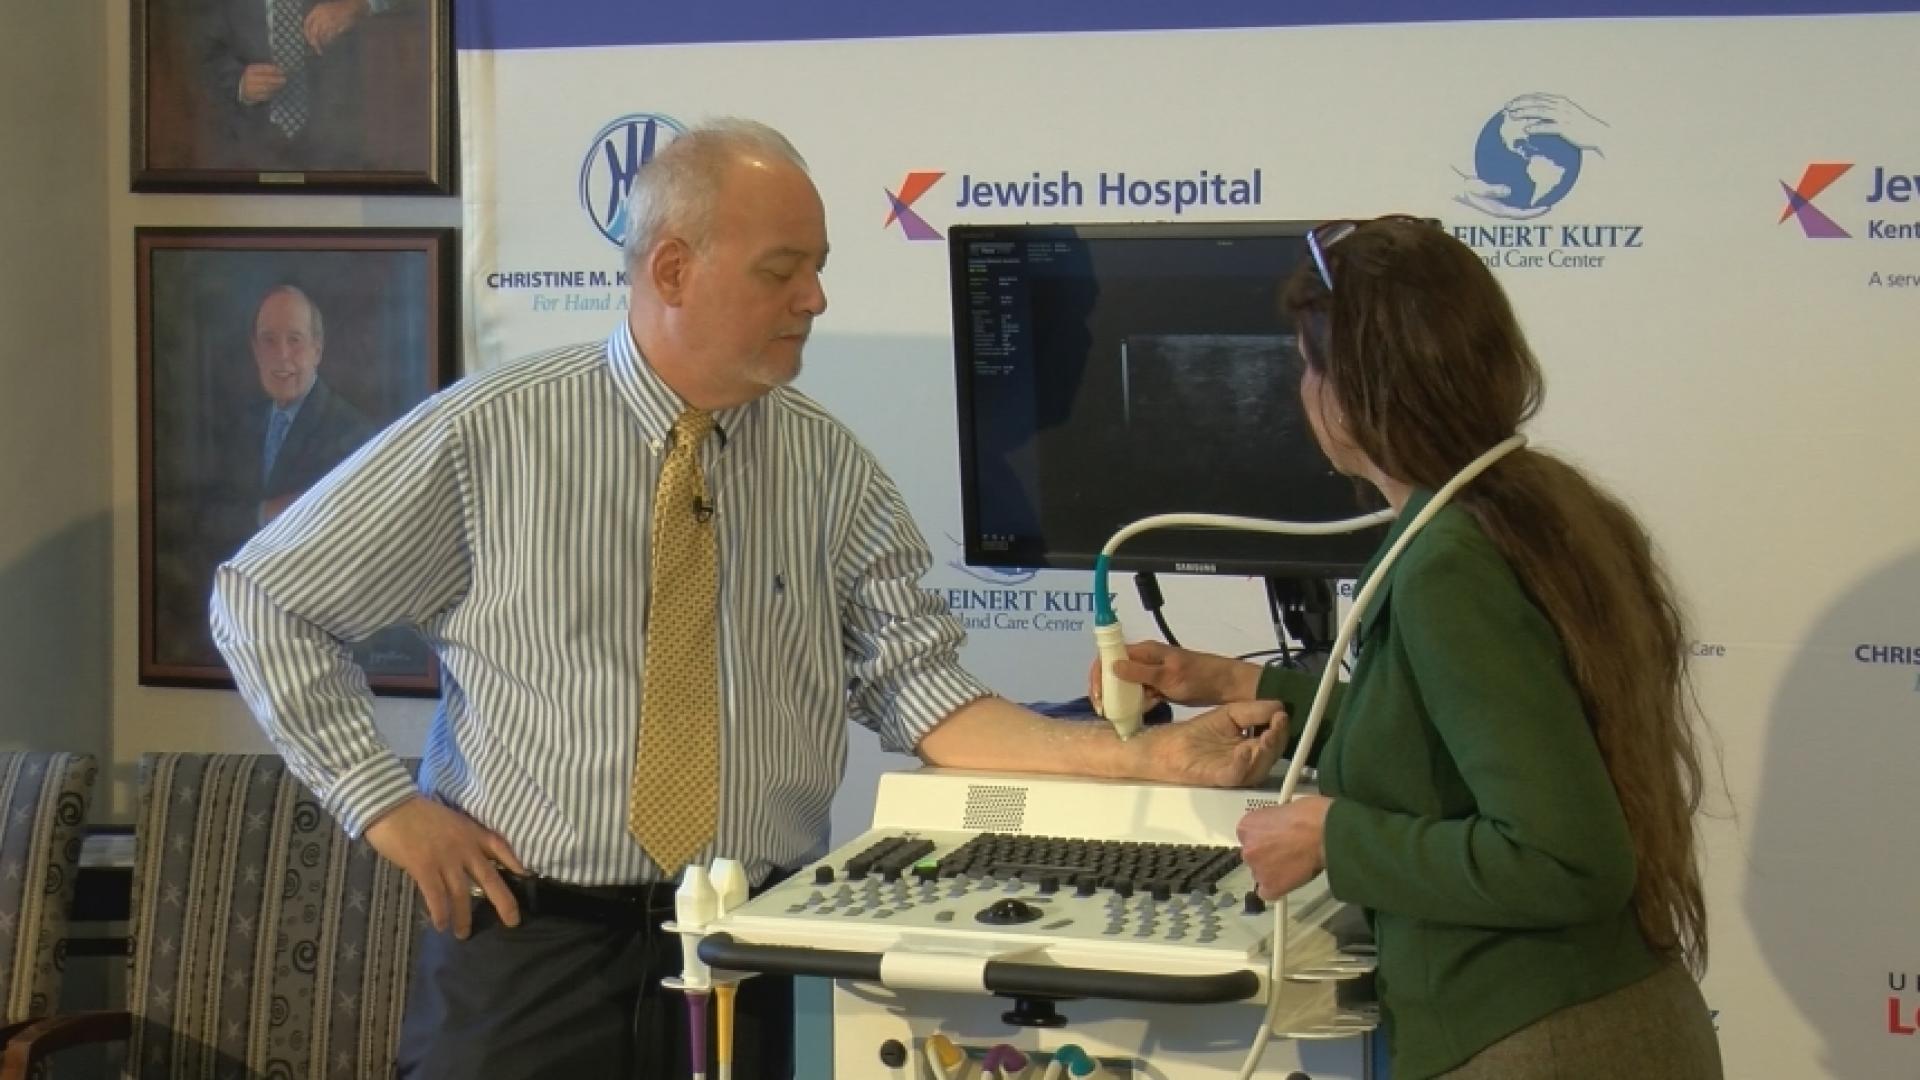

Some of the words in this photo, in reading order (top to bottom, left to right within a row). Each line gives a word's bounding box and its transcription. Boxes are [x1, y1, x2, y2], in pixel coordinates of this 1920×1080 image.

[956, 170, 1083, 207] Jewish
[1100, 169, 1262, 214] Hospital
[1453, 225, 1552, 247] EINERT
[1562, 225, 1643, 248] KUTZ
[1504, 249, 1544, 268] Care
[1549, 250, 1605, 268] Center
[487, 271, 584, 288] CHRISTINE
[589, 271, 611, 286] M.
[1868, 271, 1882, 286] A
[533, 293, 560, 311] For
[565, 293, 611, 311] Hand
[920, 587, 1037, 612] EINERT
[994, 613, 1029, 630] Care
[1033, 613, 1085, 632] Center
[1689, 640, 1727, 657] Care
